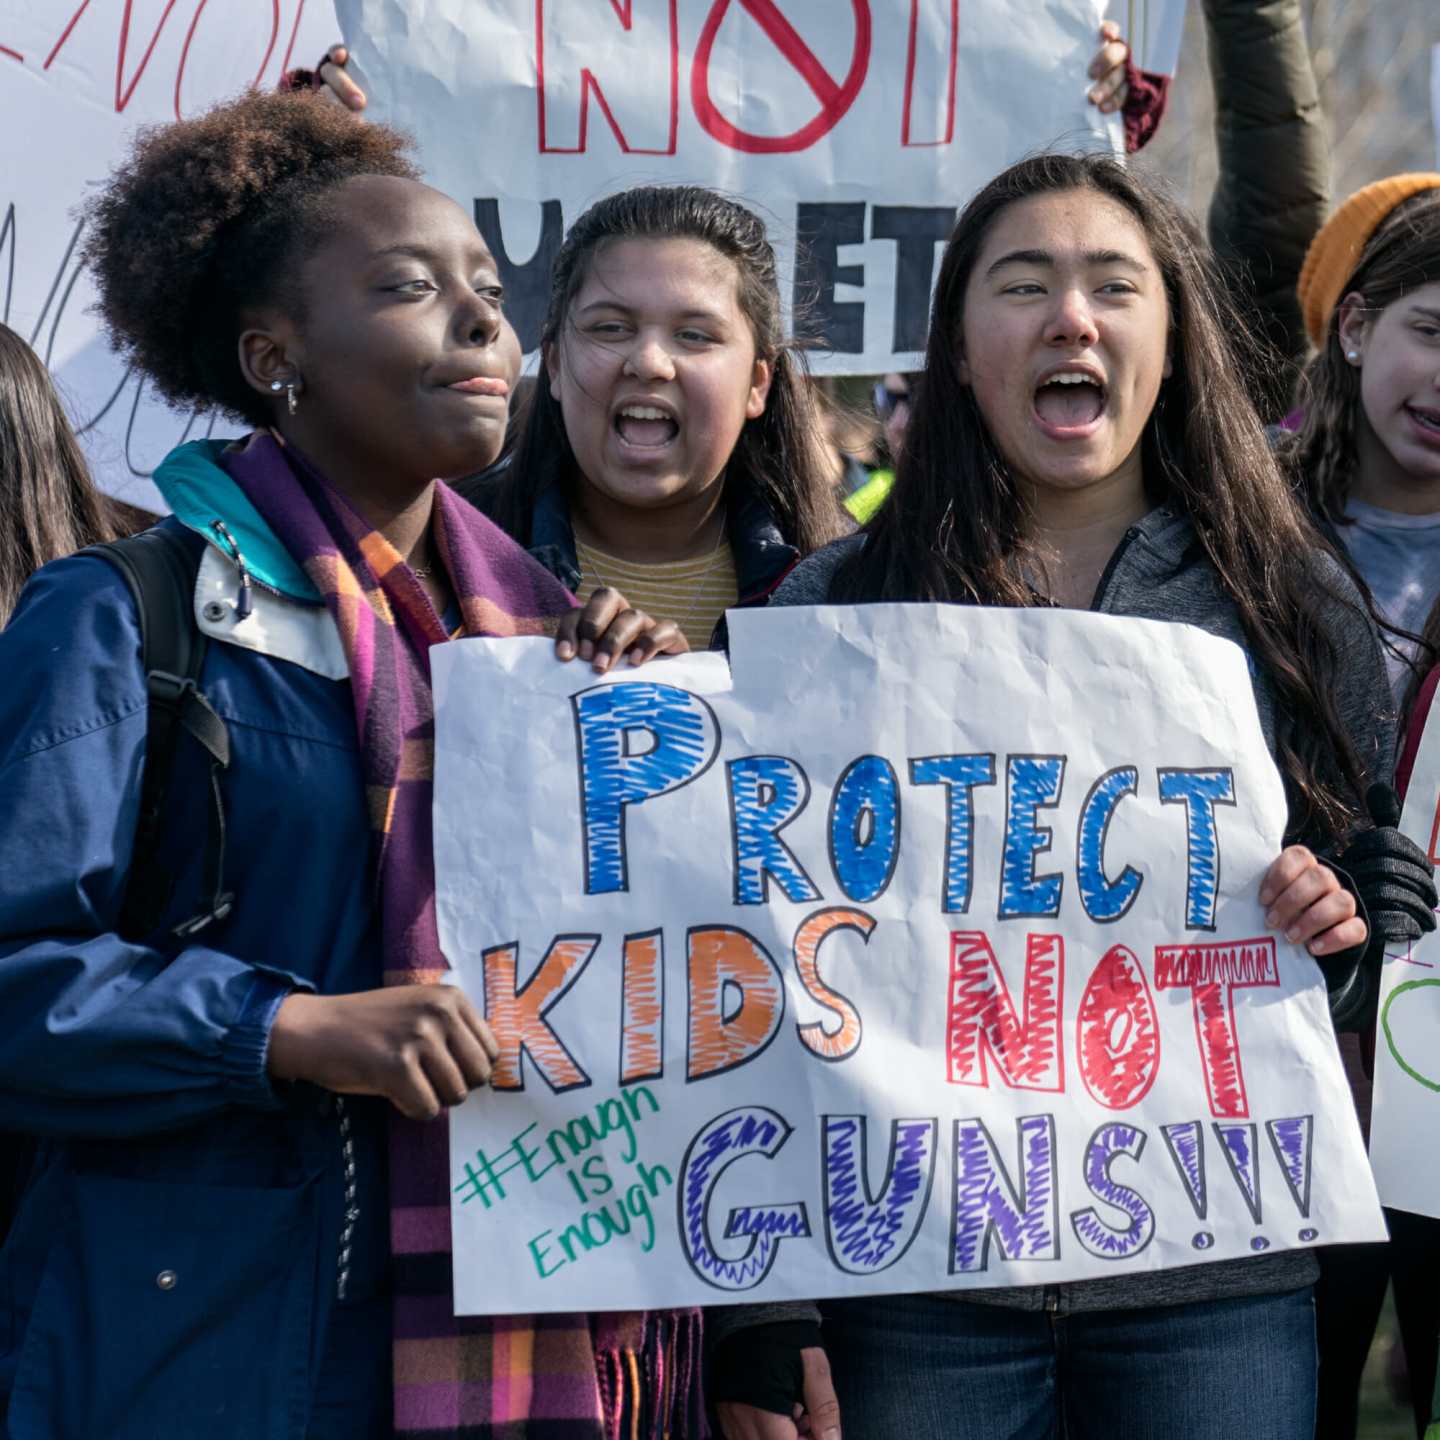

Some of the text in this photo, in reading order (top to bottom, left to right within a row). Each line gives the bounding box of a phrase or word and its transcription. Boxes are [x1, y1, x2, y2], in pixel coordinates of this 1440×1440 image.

[569, 681, 1238, 931] PROTECT
[481, 906, 1280, 1118] KIDS NOT
[454, 1086, 660, 1209] #Enough
[528, 1162, 672, 1279] Enough
[678, 1104, 1315, 1290] GUNS!!!
